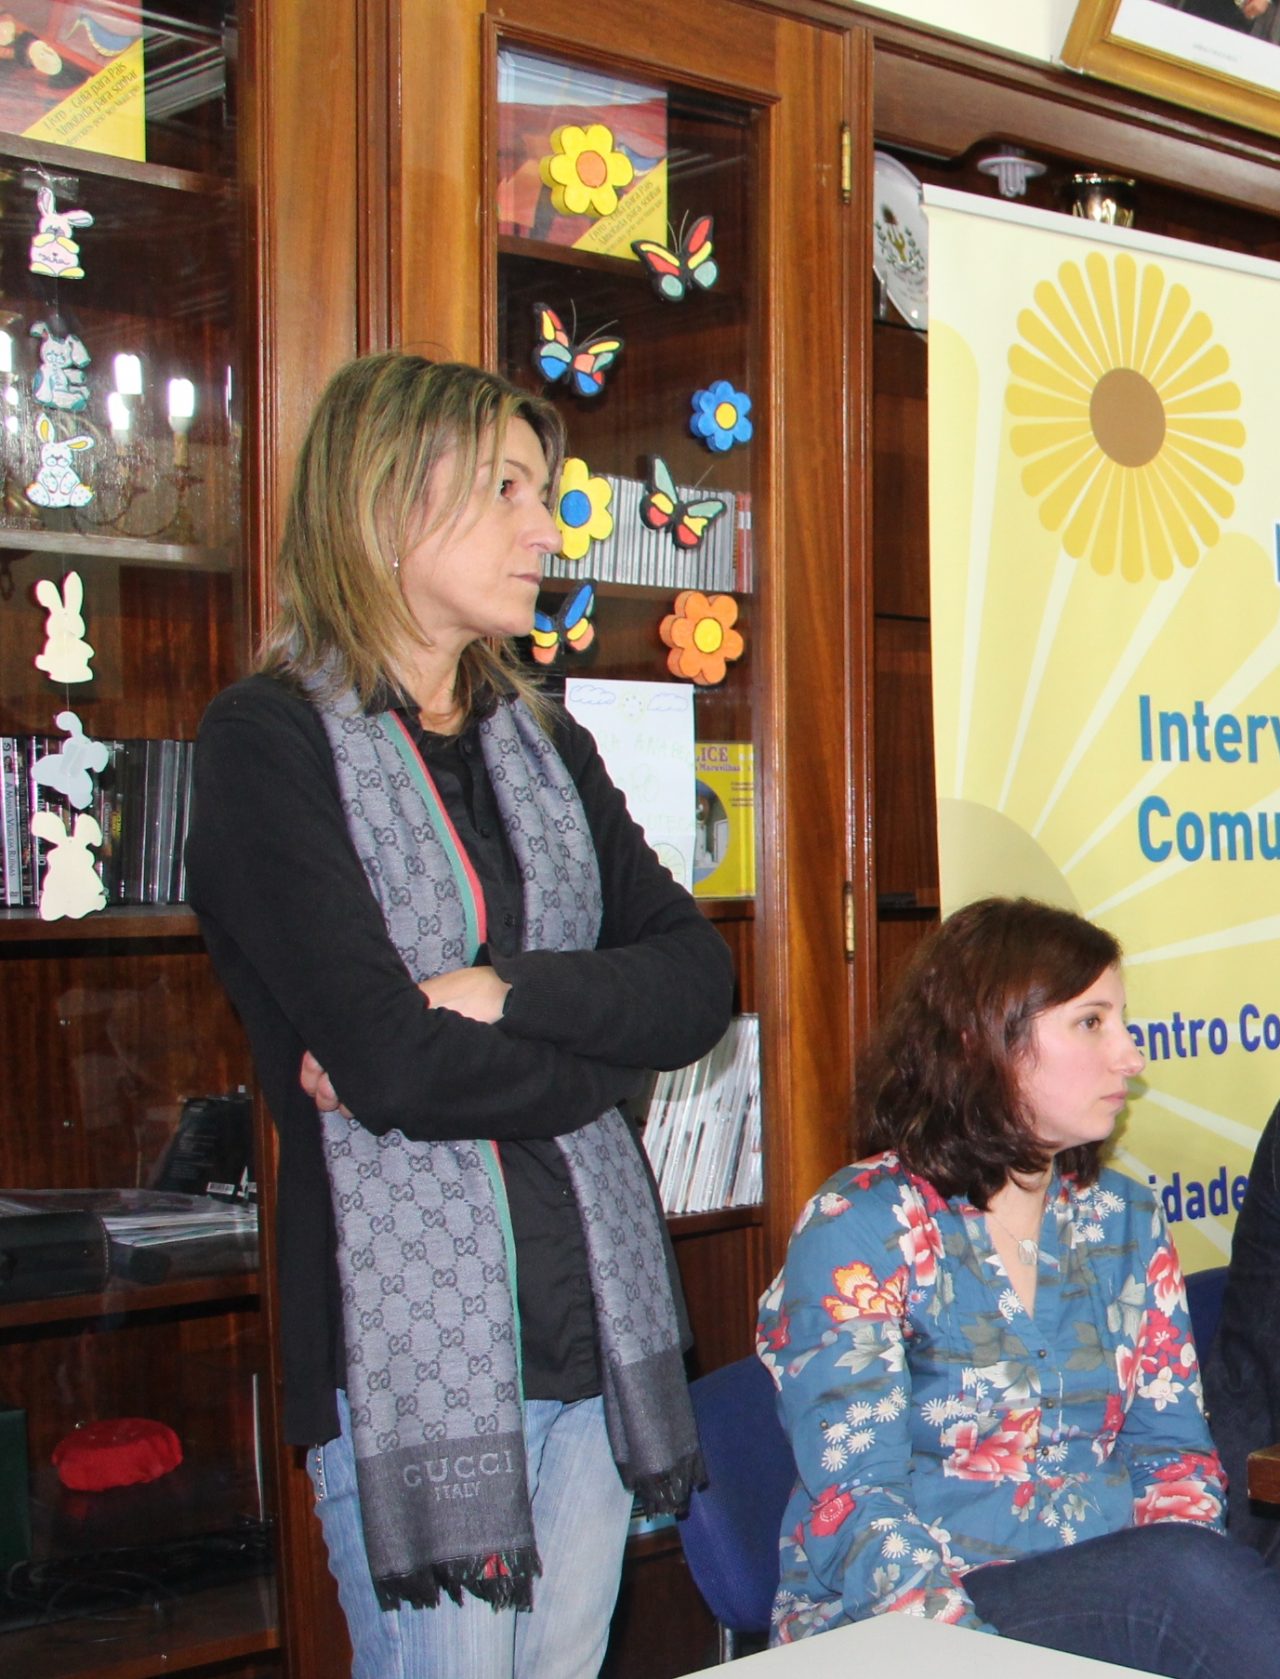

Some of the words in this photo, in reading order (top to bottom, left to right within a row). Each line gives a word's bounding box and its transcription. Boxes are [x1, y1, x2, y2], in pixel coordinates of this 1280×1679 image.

[697, 746, 729, 762] ICE
[1126, 1012, 1229, 1061] entro
[403, 1450, 514, 1487] GUCCI
[433, 1481, 481, 1501] ITALY
